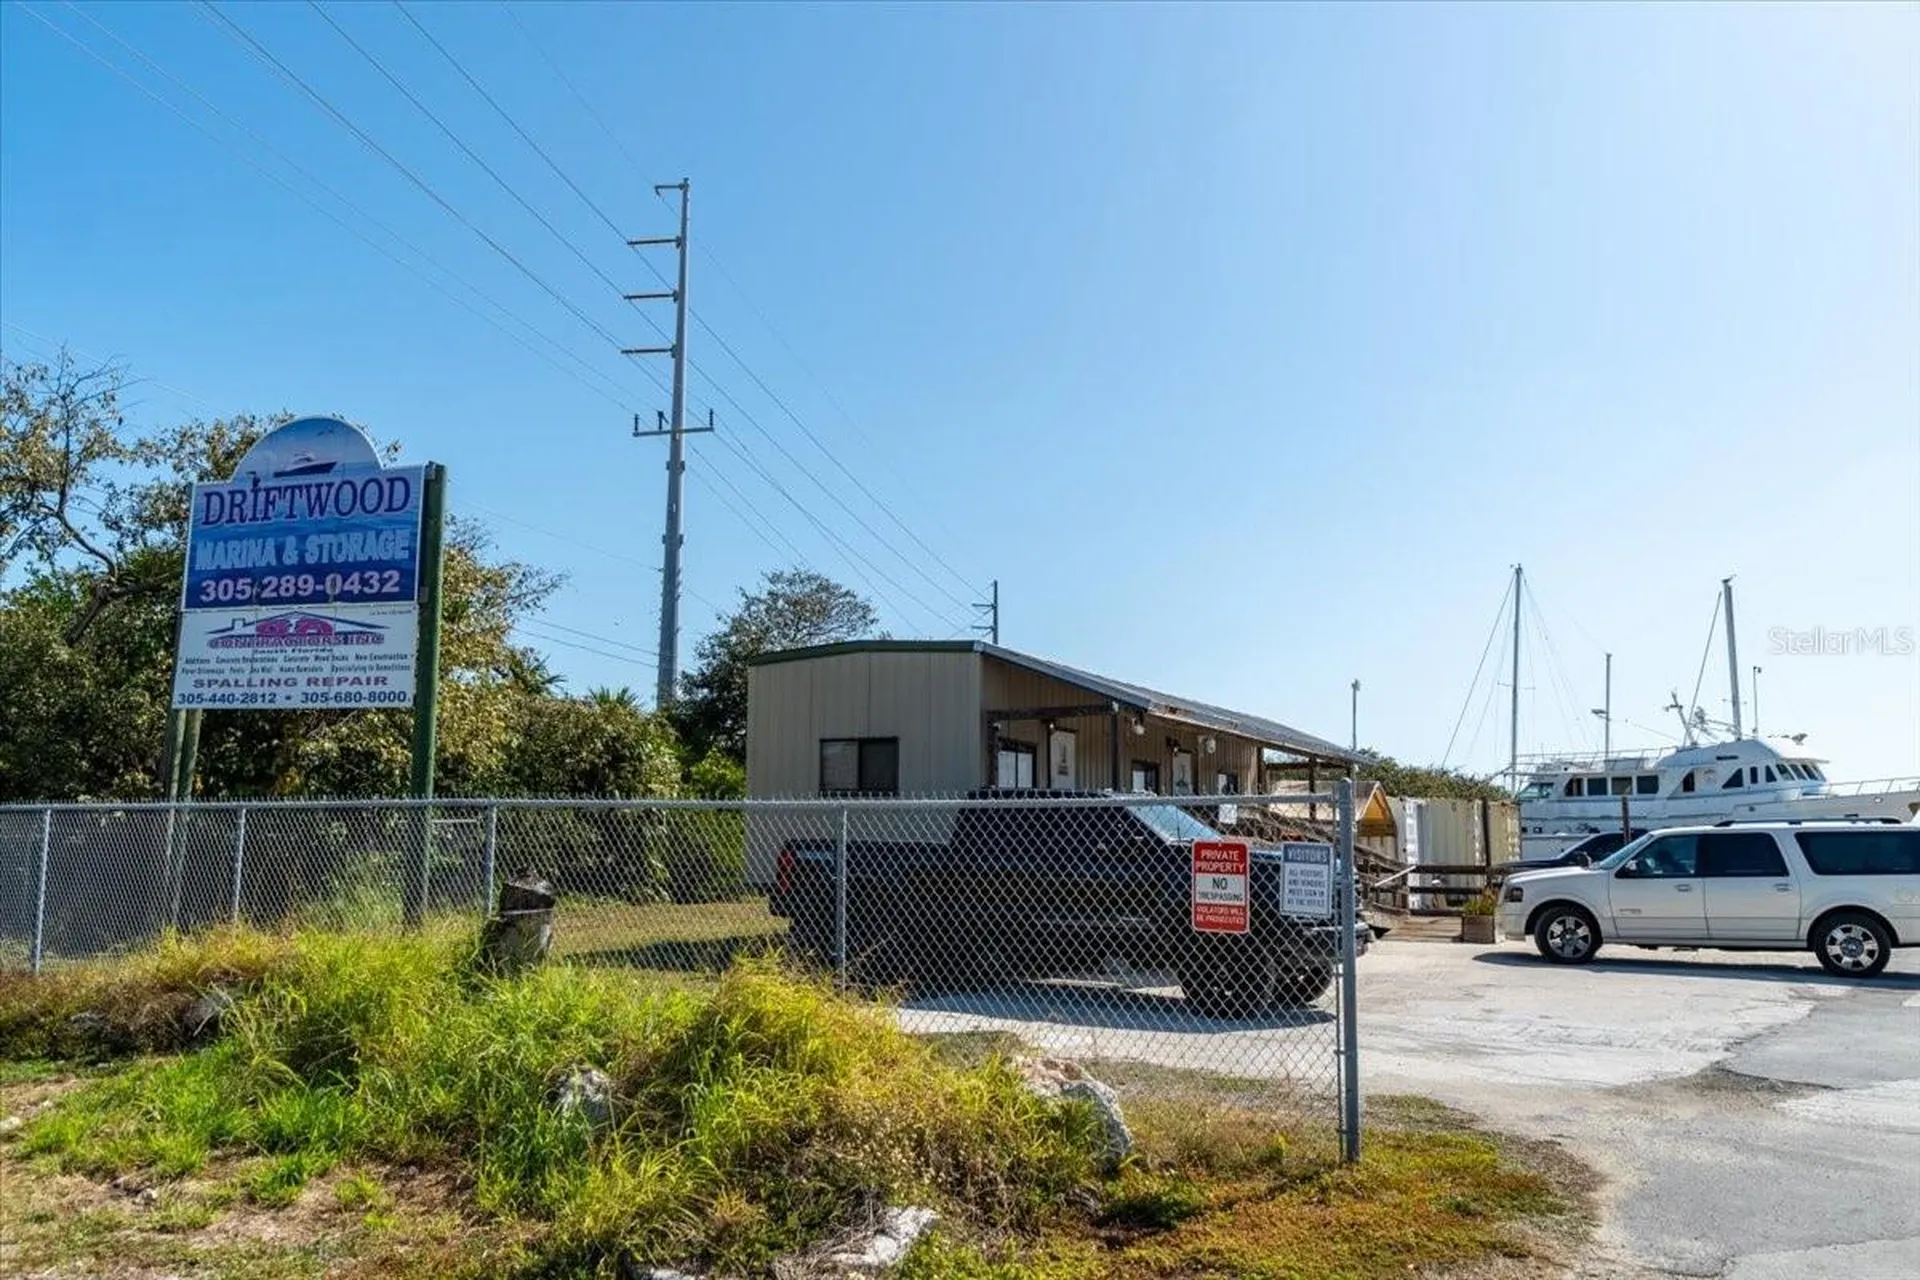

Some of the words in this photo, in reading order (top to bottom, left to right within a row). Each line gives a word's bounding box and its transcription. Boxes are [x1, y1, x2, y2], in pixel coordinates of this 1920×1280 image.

[202, 477, 411, 526] DRIFTWOOD
[195, 538, 278, 570] MARINA
[282, 537, 299, 565] &
[305, 529, 410, 563] STORAGE
[200, 570, 400, 602] 305-289-0432
[193, 676, 298, 689] SPALLING
[306, 675, 389, 688] REPAIR
[177, 691, 278, 706] 305-440-2812
[300, 690, 407, 704] 305-680-8000
[1201, 849, 1239, 861] PRIVATE
[1287, 848, 1327, 862] VISITORS
[1196, 861, 1245, 872] PROPERTY
[1212, 877, 1228, 890] NO
